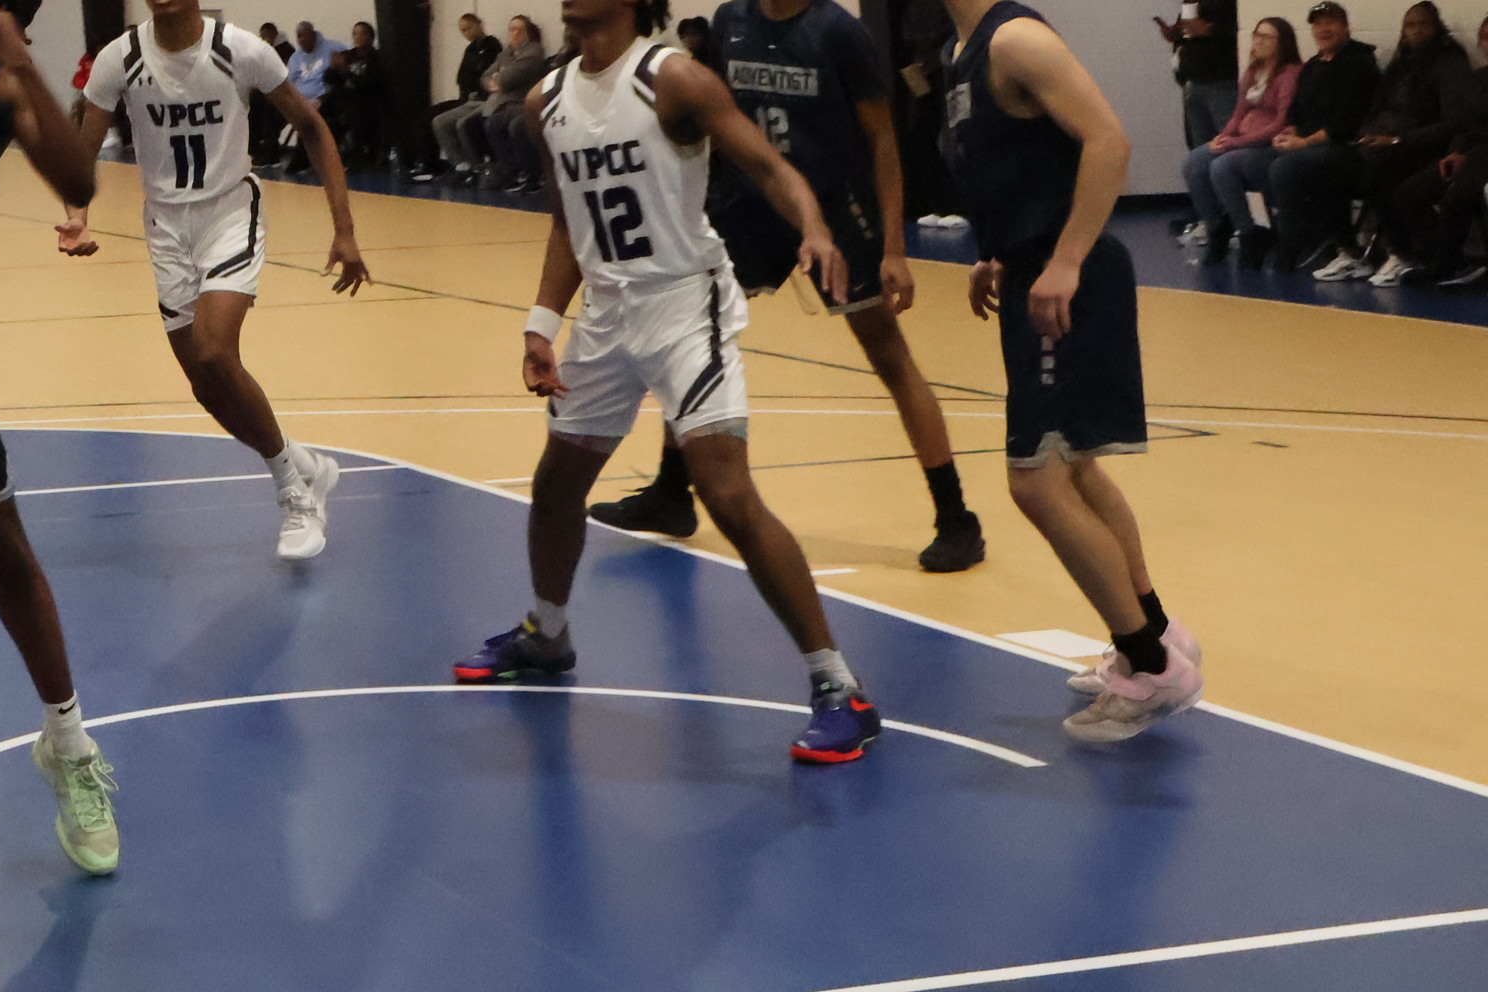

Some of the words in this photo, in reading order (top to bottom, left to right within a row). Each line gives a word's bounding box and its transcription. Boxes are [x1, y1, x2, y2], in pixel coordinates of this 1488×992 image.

[146, 100, 223, 128] VPCC
[170, 134, 206, 189] 11
[560, 140, 647, 183] VPCC
[583, 185, 653, 262] 12
